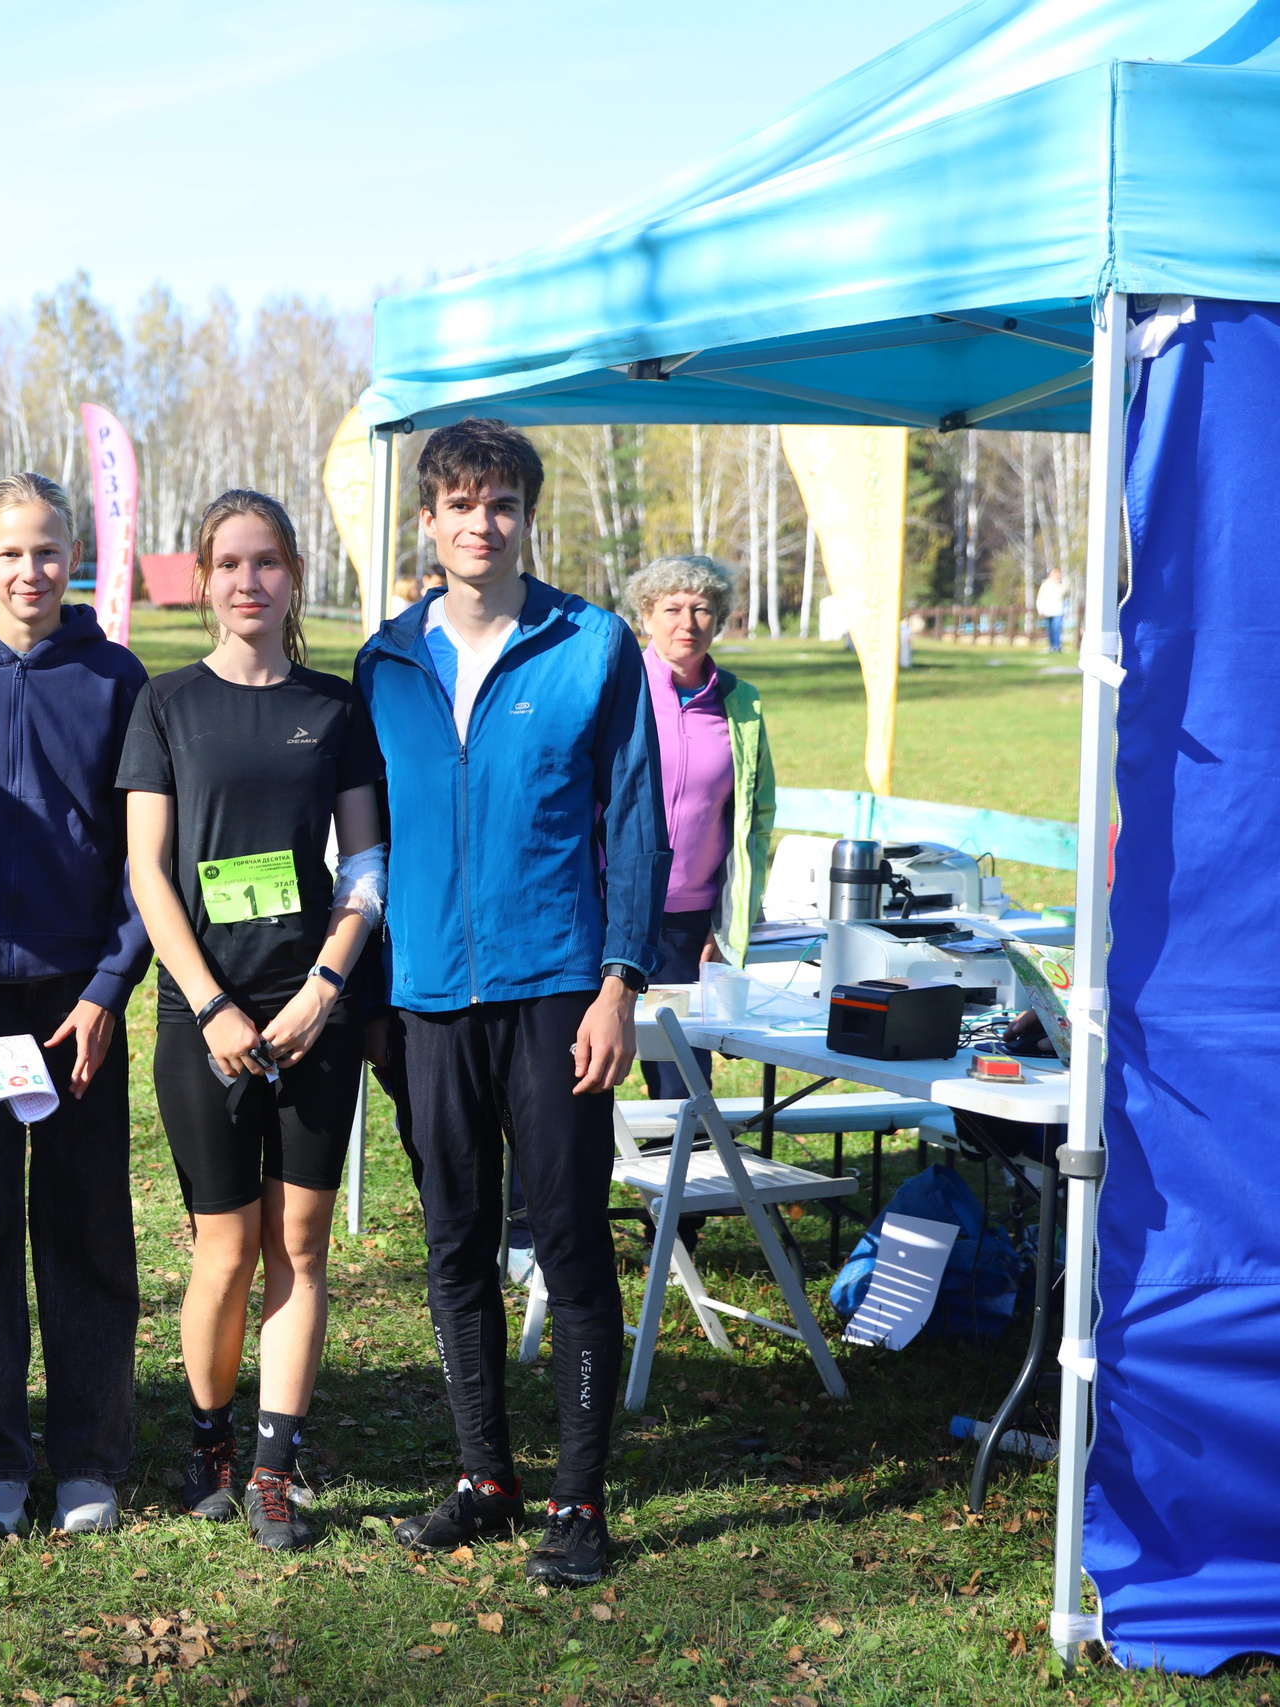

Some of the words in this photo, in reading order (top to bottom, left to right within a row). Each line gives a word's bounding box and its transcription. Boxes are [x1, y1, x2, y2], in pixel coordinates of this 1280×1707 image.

[99, 425, 121, 519] РОЗА
[262, 855, 290, 863] ДЕСЯТКА
[274, 880, 295, 888] ЭТАП
[281, 888, 291, 910] 6
[243, 885, 258, 916] 1
[434, 1325, 452, 1384] ARSWEAR
[580, 1350, 592, 1410] ARSWEAR
